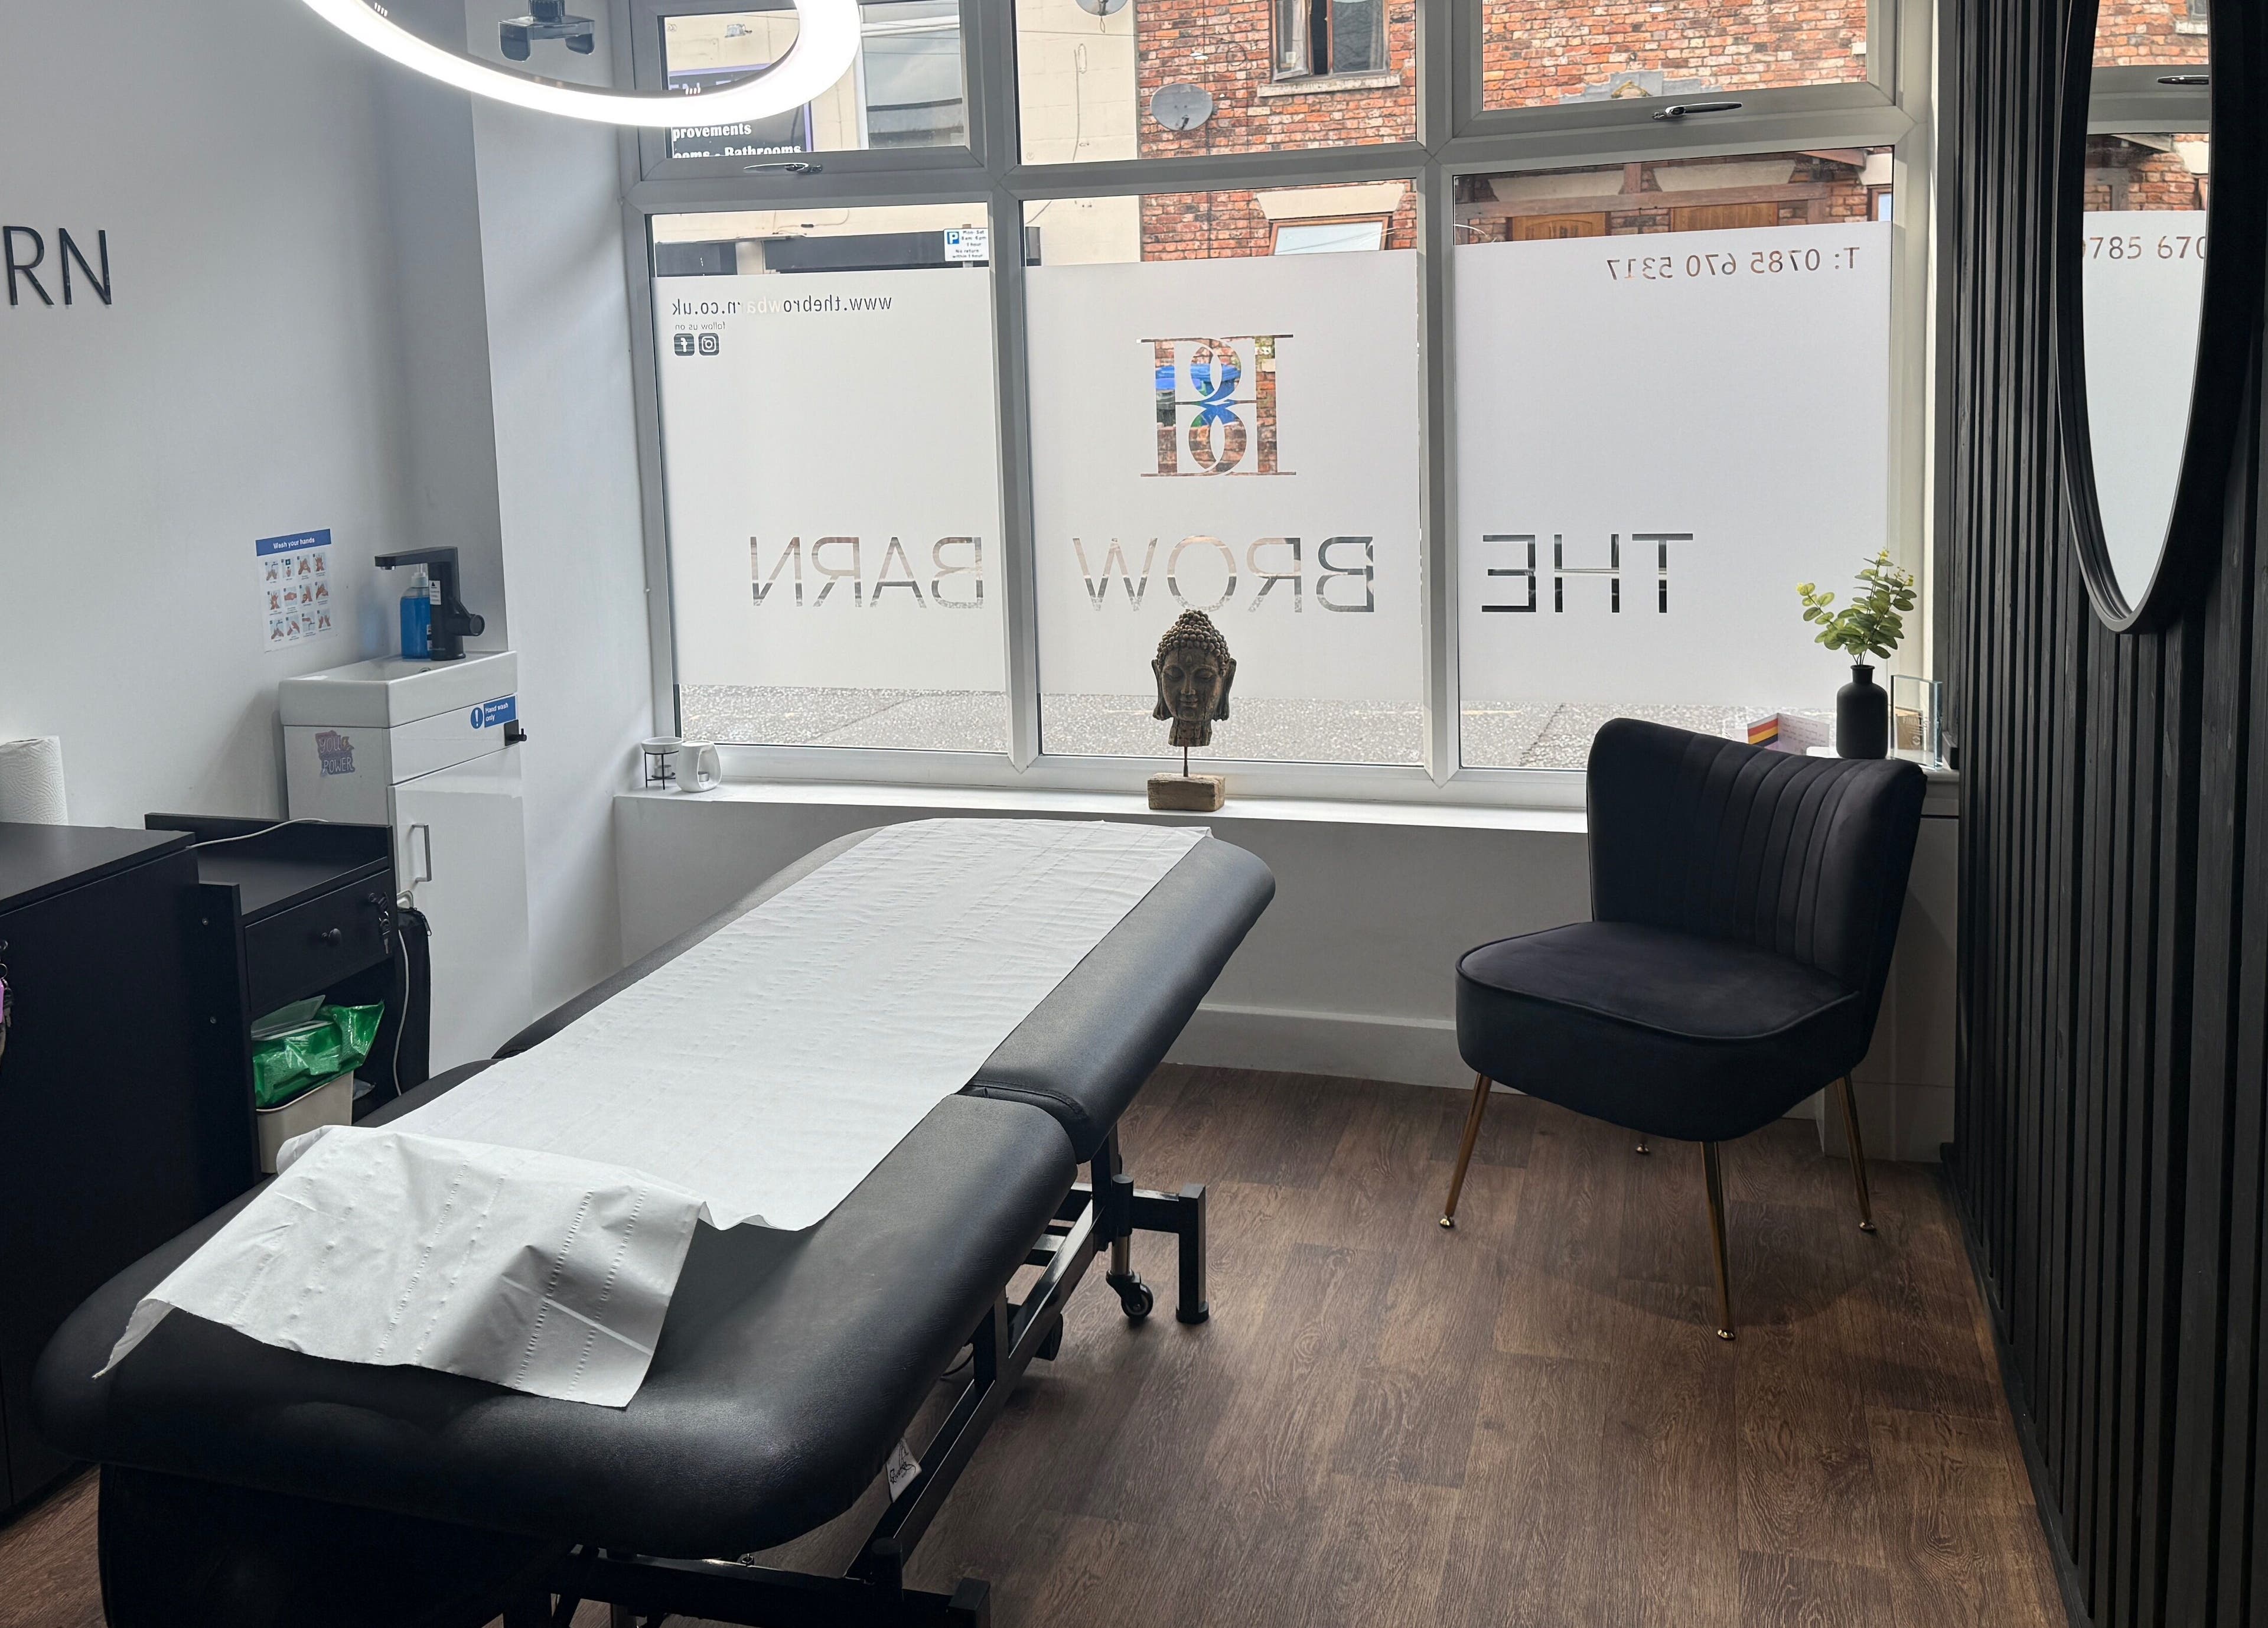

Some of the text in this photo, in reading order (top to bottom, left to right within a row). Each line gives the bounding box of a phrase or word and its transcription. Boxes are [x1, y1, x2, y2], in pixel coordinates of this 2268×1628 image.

[672, 123, 752, 142] provements
[2083, 236, 2143, 260] 785
[3, 226, 112, 305] RN
[288, 540, 299, 549] your
[300, 537, 315, 545] hands
[485, 702, 509, 714] Hand wash
[485, 714, 496, 722] only
[322, 756, 354, 773] POWER
